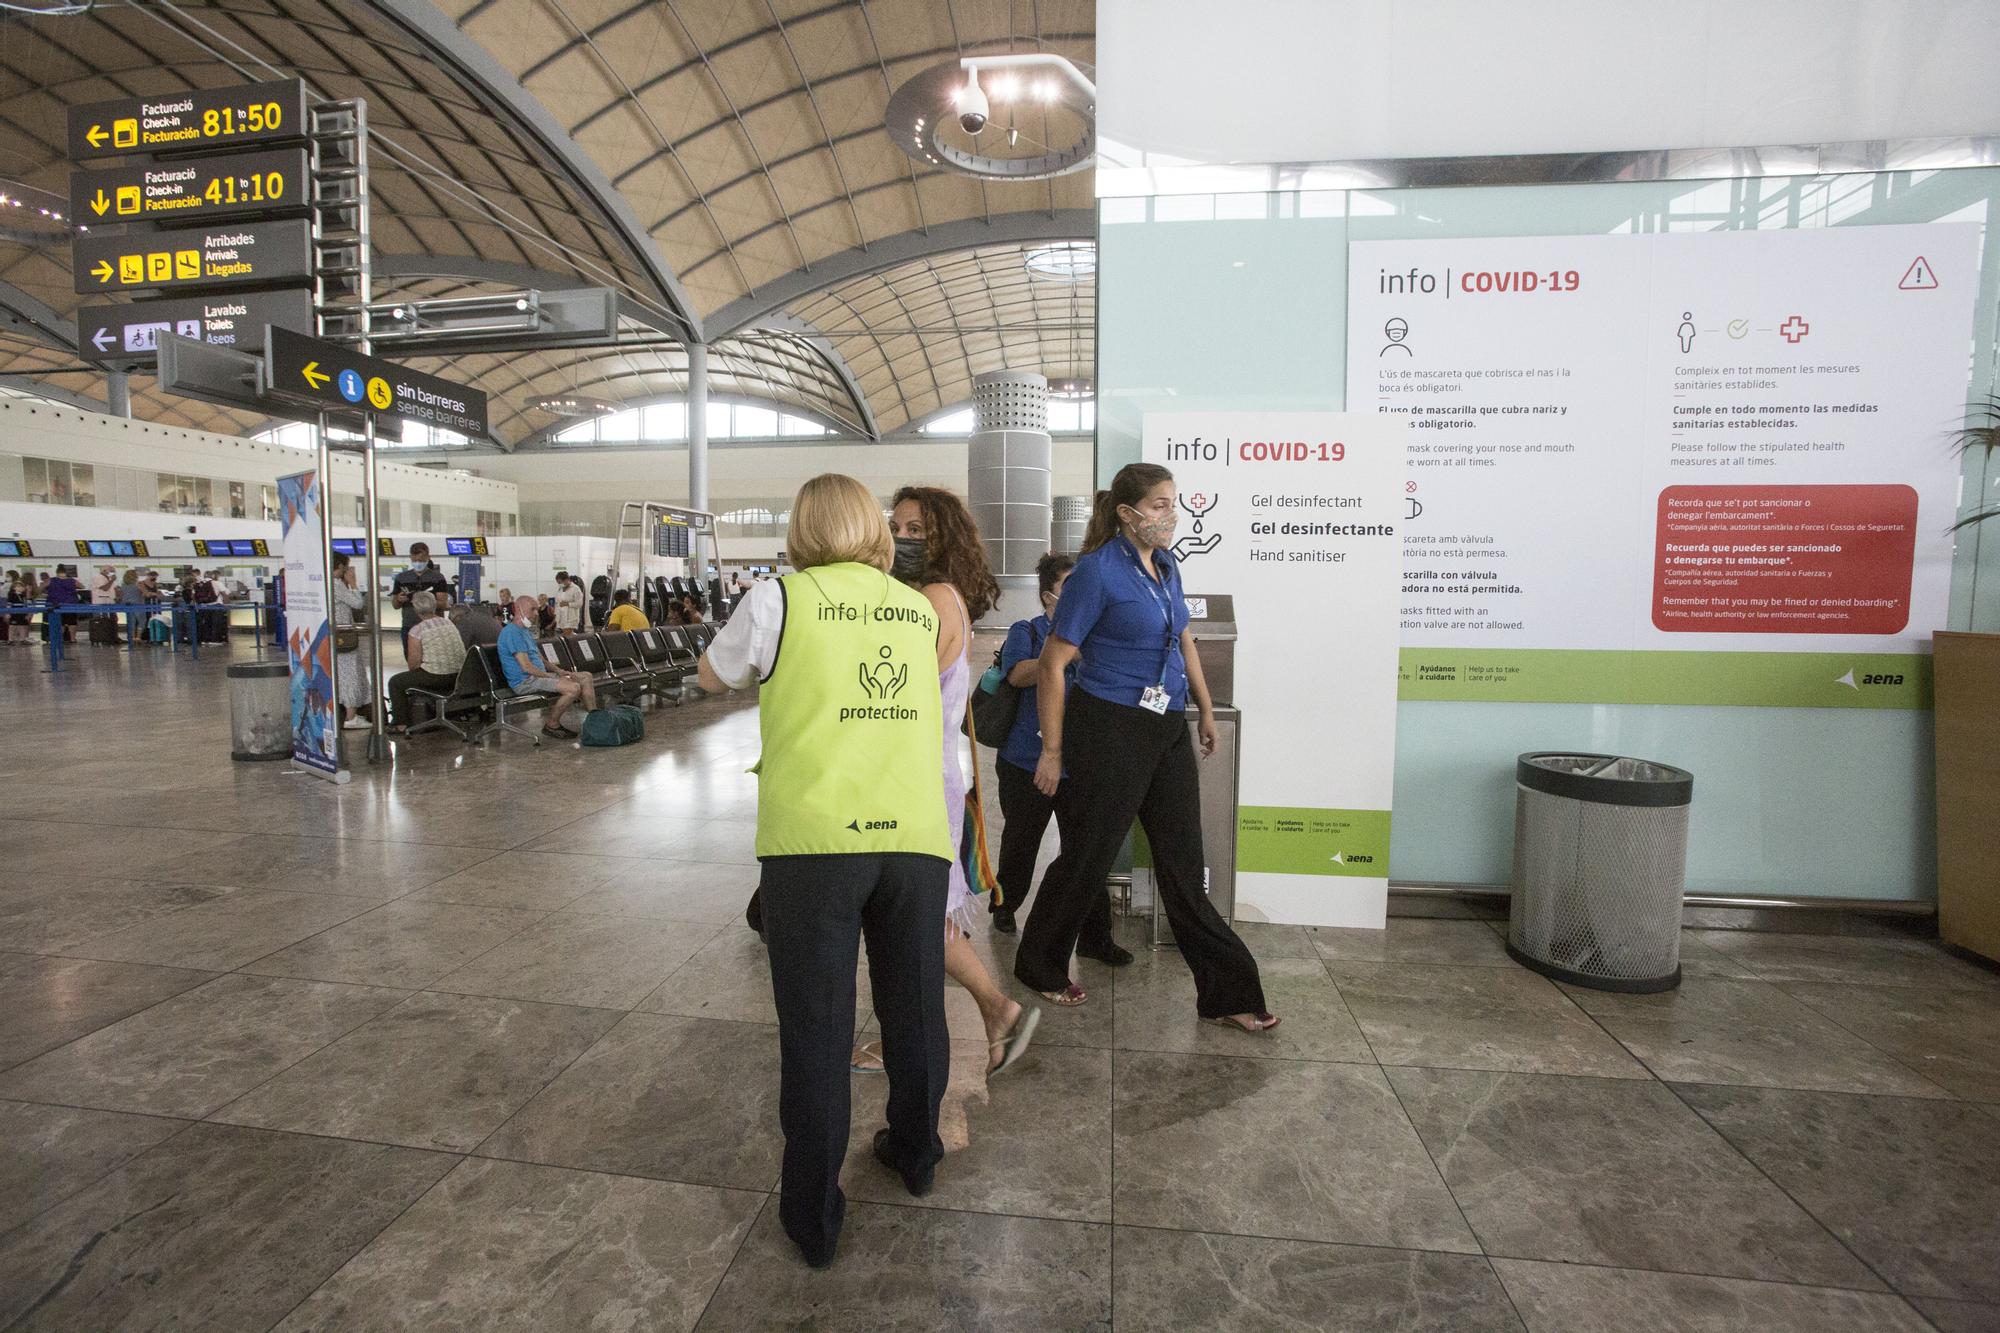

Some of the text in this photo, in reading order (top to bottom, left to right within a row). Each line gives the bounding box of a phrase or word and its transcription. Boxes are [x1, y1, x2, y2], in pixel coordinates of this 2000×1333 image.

[142, 100, 193, 115] Facturació
[143, 116, 180, 129] Check-in
[203, 102, 282, 136] 81 to 50
[143, 127, 200, 144] Facturación
[145, 168, 196, 184] Facturació
[146, 184, 183, 196] Check-in
[204, 172, 284, 204] 41 to 10
[146, 195, 202, 210] Facturación
[205, 233, 254, 248] Arribades
[205, 249, 238, 261] Arrivals
[206, 262, 252, 277] Llegadas
[1379, 268, 1580, 294] info COVID-19
[205, 304, 247, 317] Lavabos
[204, 319, 234, 330] Toilets
[206, 334, 236, 344] Aseos
[1400, 370, 1412, 378] de
[1414, 370, 1462, 378] mascareta
[1464, 370, 1482, 379] que
[1485, 369, 1523, 378] cobrisca
[1526, 368, 1534, 377] el
[1562, 368, 1570, 376] la
[1675, 366, 1719, 376] Compleix
[1756, 366, 1796, 374] moment
[1800, 365, 1814, 374] les
[1379, 382, 1463, 394] boca és obligatori.
[1725, 380, 1778, 388] establides.
[396, 382, 466, 414] sin barreras
[1411, 406, 1424, 414] de
[1426, 406, 1476, 414] mascarilla
[1480, 407, 1498, 416] que
[1502, 406, 1529, 414] cubra
[1532, 405, 1558, 414] nariz
[1561, 406, 1567, 416] y
[1673, 406, 1712, 416] Cumple
[1732, 405, 1756, 414] todo
[1759, 405, 1810, 414] momento
[1814, 404, 1828, 412] las
[1832, 404, 1878, 412] medidas
[397, 400, 480, 432] sense barreres
[1418, 420, 1476, 430] obligatorio.
[1672, 419, 1798, 428] sanitarias establecidas.
[1167, 438, 1345, 462] info COVID-19
[1434, 444, 1472, 454] covering
[1476, 445, 1496, 454] your
[1524, 443, 1542, 452] and
[1544, 443, 1574, 452] mouth
[1672, 442, 1844, 452] Please follow the stipulated health
[1455, 458, 1466, 466] all
[1470, 458, 1496, 466] times.
[1733, 457, 1744, 466] all
[1748, 457, 1776, 466] times.
[1252, 494, 1362, 508] Gel desinfectant
[1668, 499, 1802, 508] Recorda que se't pot sancionar
[1668, 512, 1702, 520] denegar
[1251, 522, 1394, 536] Gel desinfectante
[1439, 534, 1458, 544] amb
[1466, 550, 1508, 558] permesa.
[1666, 544, 1710, 552] Recuerda
[1732, 544, 1767, 553] puedes
[1787, 544, 1842, 552] sancionado
[1250, 550, 1346, 562] Hand sanitiser
[1674, 556, 1722, 565] denegarse
[1462, 571, 1497, 580] válvula
[1448, 584, 1468, 593] está
[1472, 584, 1523, 594] permitida.
[1663, 596, 1708, 605] Remember
[1732, 599, 1748, 607] you
[1750, 599, 1770, 607] may
[1821, 598, 1851, 606] denied
[1426, 606, 1452, 615] fitted
[1454, 606, 1474, 616] with
[1714, 610, 1746, 618] authority
[818, 602, 932, 632] info COVID-19
[1424, 620, 1448, 629] valve
[1468, 621, 1484, 629] not
[1486, 620, 1524, 630] allowed.
[1420, 665, 1456, 673] Ayúdanos
[1469, 666, 1520, 674] Help take
[1862, 674, 1904, 685] aena
[840, 705, 918, 722] protection
[865, 819, 897, 830] aena
[1346, 855, 1373, 863] aena
